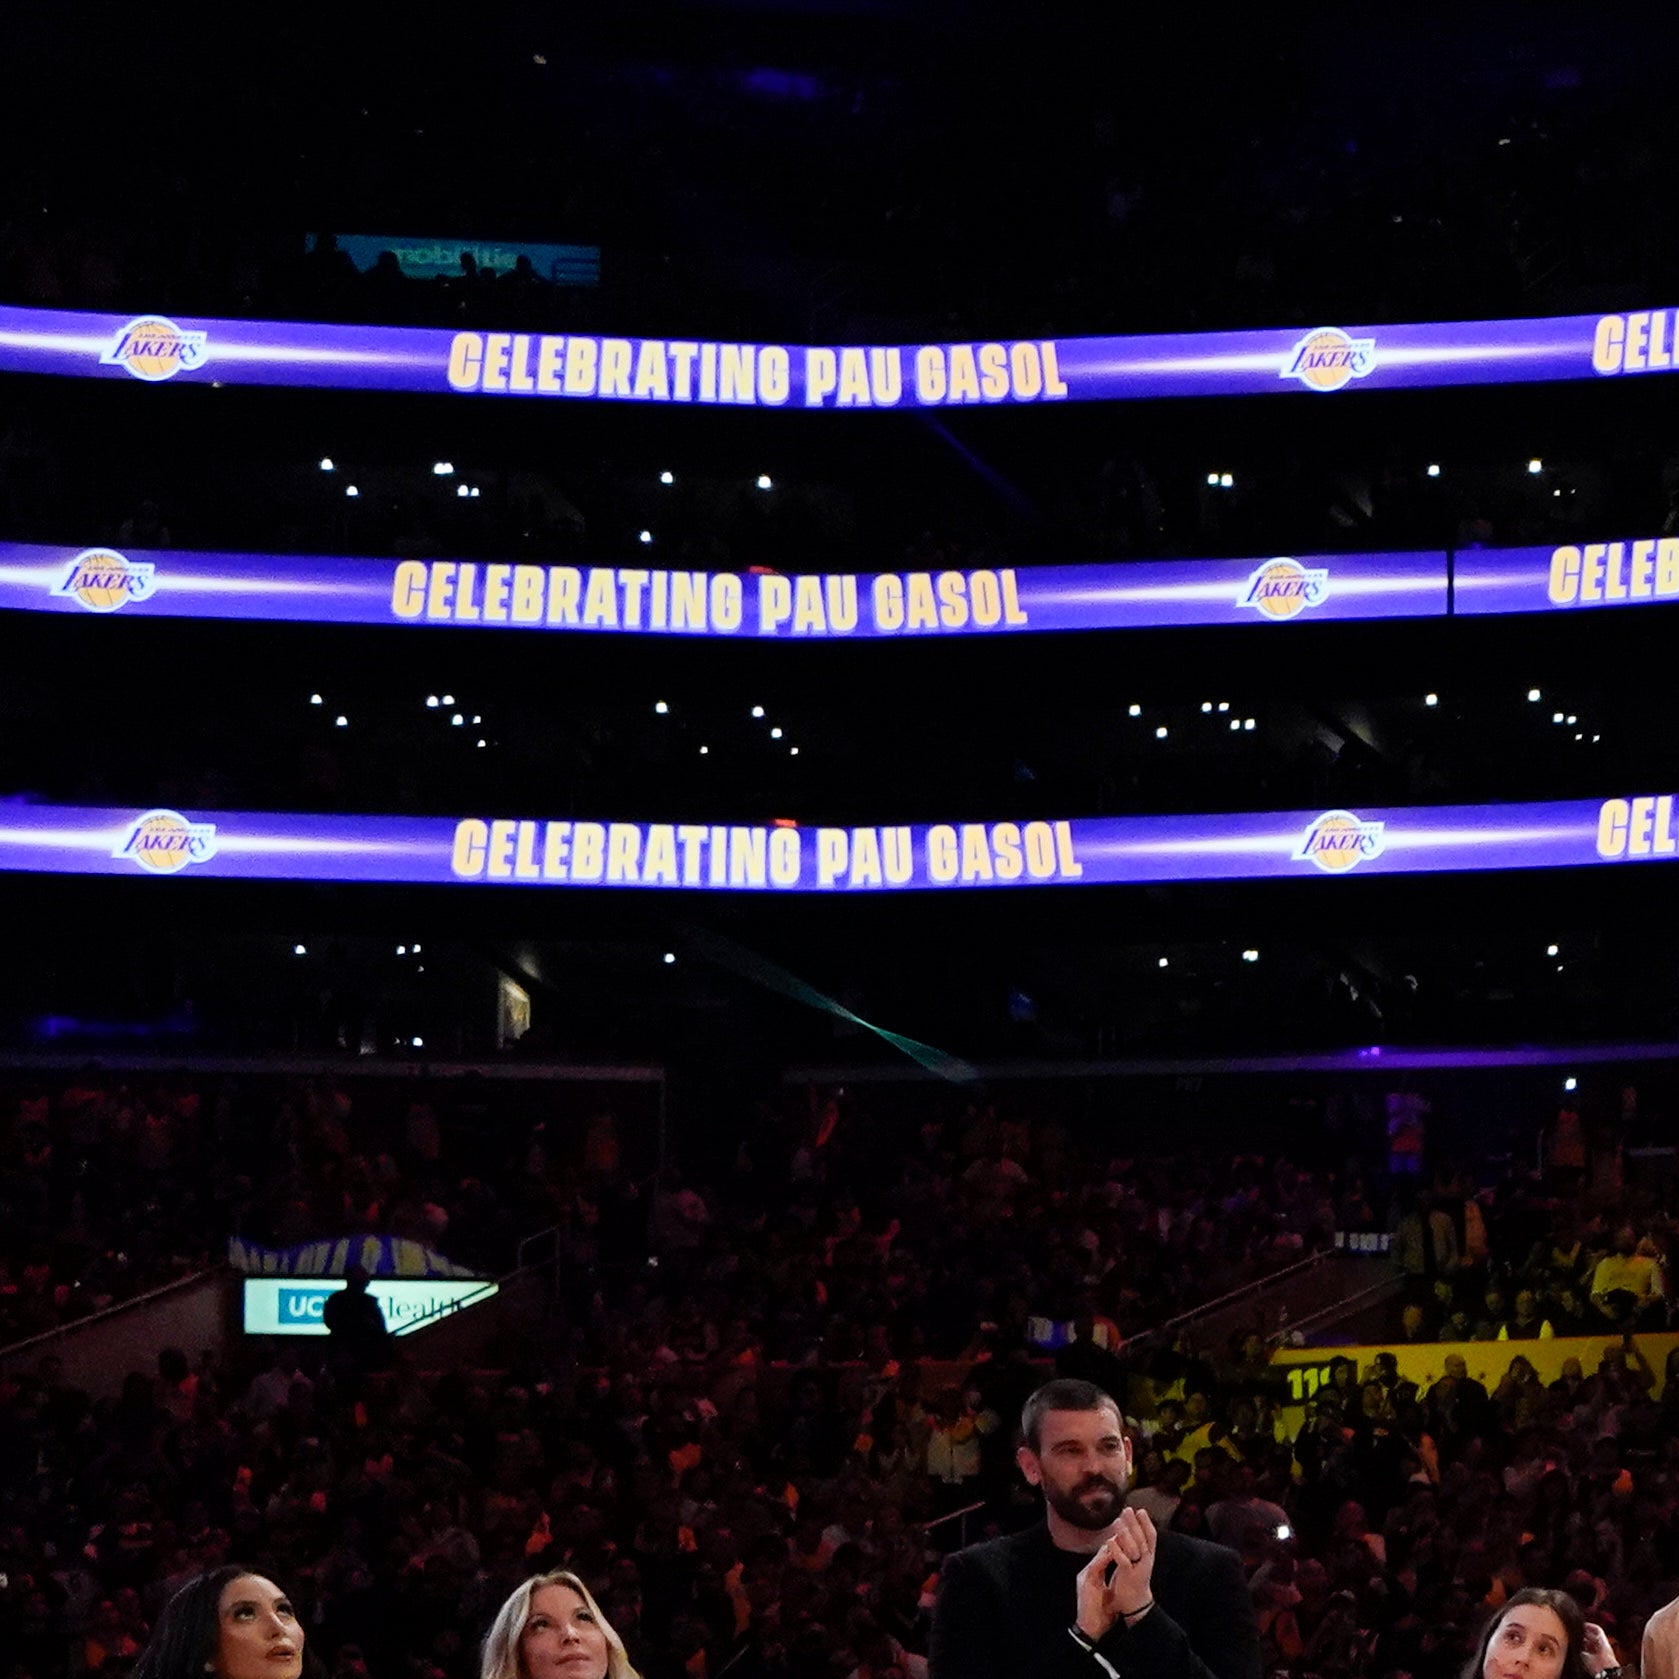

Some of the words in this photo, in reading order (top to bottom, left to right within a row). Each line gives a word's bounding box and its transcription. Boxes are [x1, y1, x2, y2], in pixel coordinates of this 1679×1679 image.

[112, 333, 198, 365] LAKERS
[1290, 346, 1369, 376] LAKERS
[447, 332, 791, 405] CELEBRATING
[805, 347, 903, 405] PAU
[915, 341, 1069, 403] GASOL
[62, 566, 145, 595] LAKERS
[1247, 576, 1320, 602] LAKERS
[390, 561, 743, 633] CELEBRATING
[759, 574, 859, 633] PAU
[873, 569, 1029, 632] GASOL
[123, 828, 206, 856] LAKERS
[450, 819, 802, 888] CELEBRATING
[816, 826, 914, 889] PAU
[926, 821, 1084, 883] GASOL
[1302, 830, 1375, 855] LAKERS
[288, 1295, 328, 1317] UC
